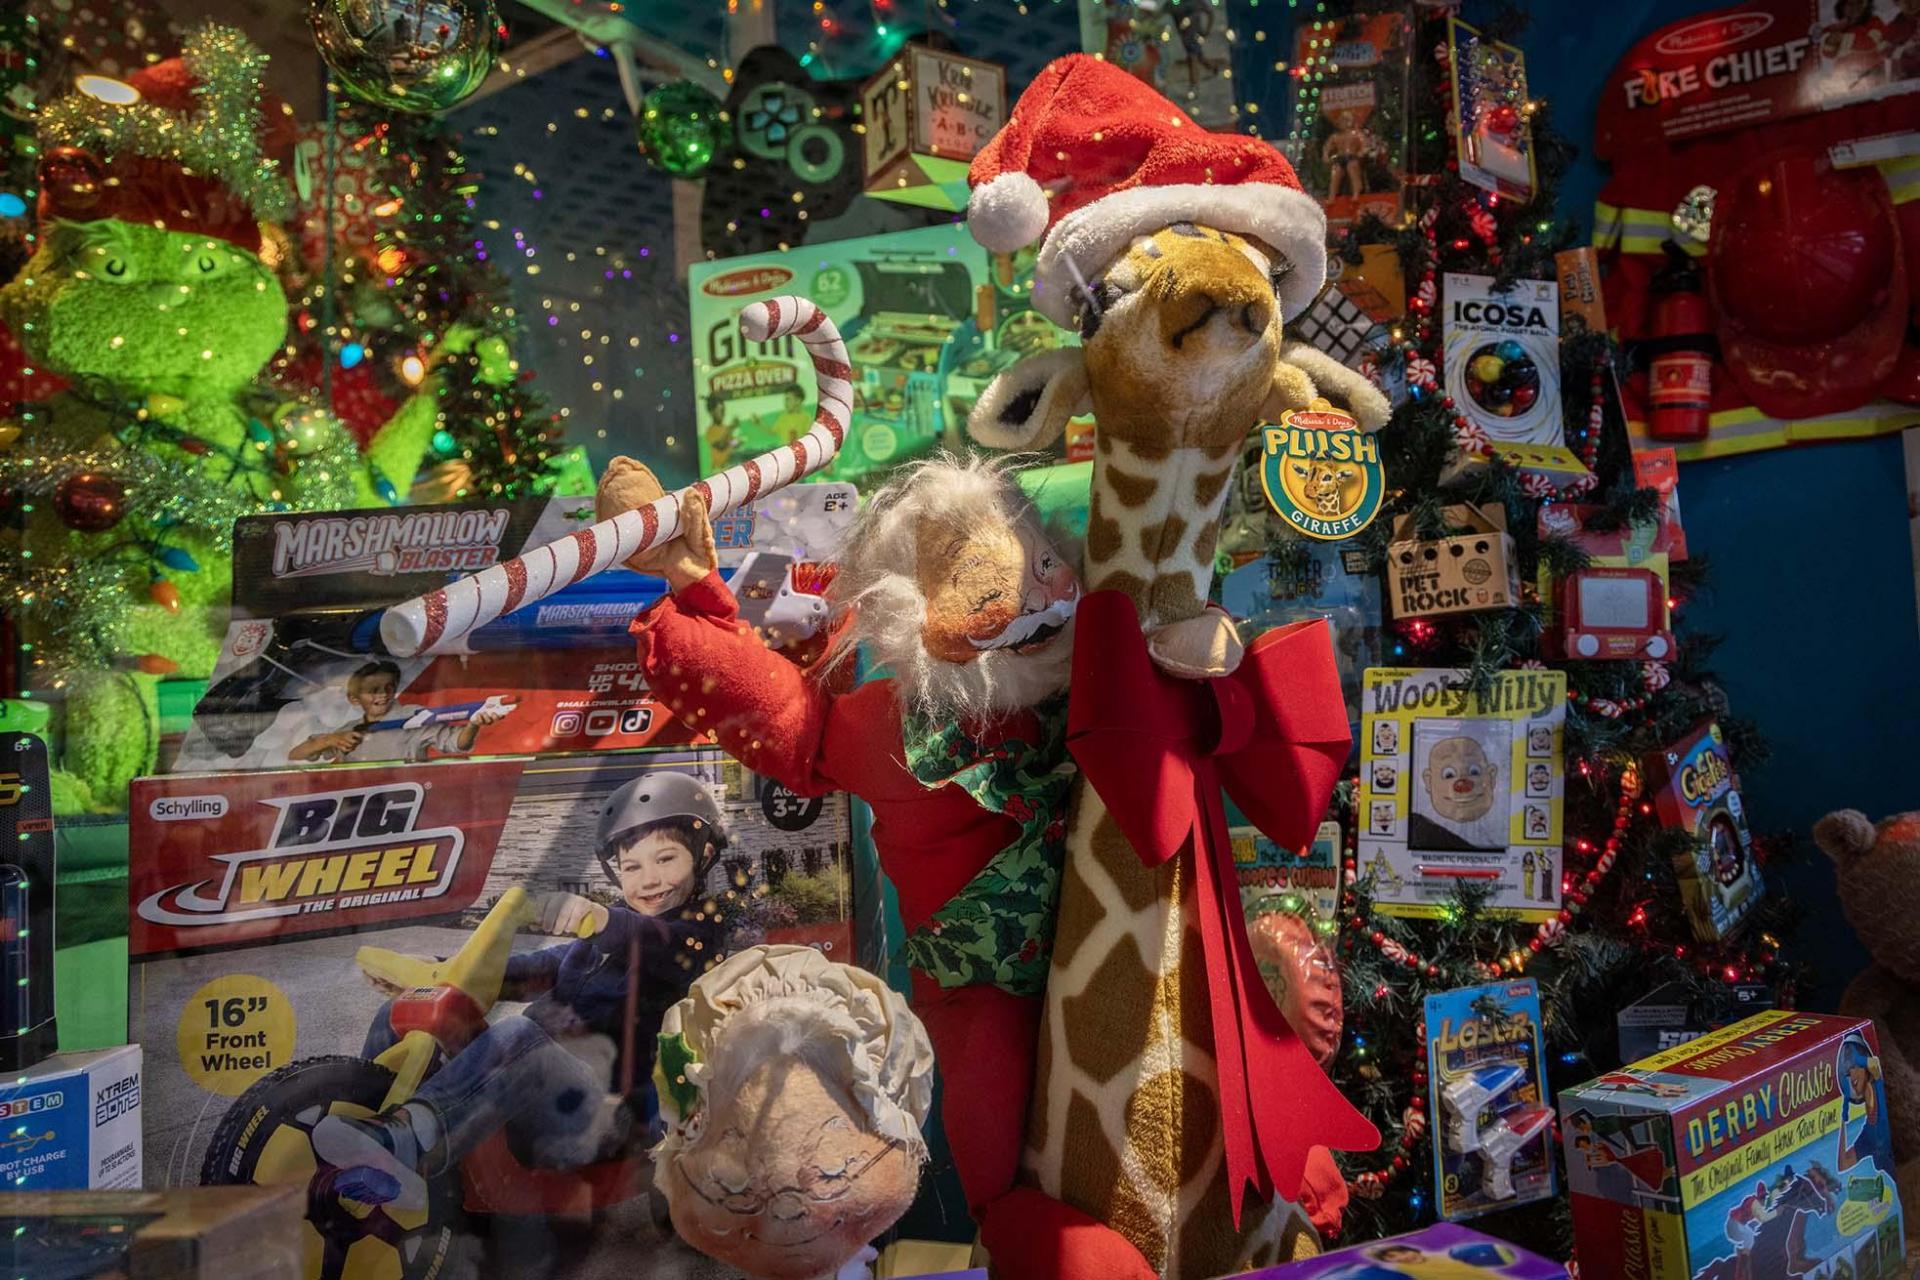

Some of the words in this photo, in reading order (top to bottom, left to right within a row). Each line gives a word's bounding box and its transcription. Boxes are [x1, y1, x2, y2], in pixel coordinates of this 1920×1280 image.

[1623, 65, 1700, 109] FIRE
[1704, 37, 1810, 89] CHIEF
[927, 86, 993, 119] KRIGLE
[1453, 301, 1549, 329] ICOSA
[712, 369, 752, 394] PIZZA
[1264, 429, 1378, 463] PLUSH
[825, 492, 849, 500] AGE
[1291, 510, 1363, 535] GIRAFFE
[272, 508, 511, 577] MARSHMALLOW
[398, 546, 499, 571] BLASTER
[1400, 572, 1441, 595] PET
[1402, 587, 1470, 613] ROCK
[537, 601, 644, 625] MARSHMALLOW
[588, 674, 615, 684] UP
[594, 662, 643, 673] SHOO
[589, 683, 613, 693] TO
[1475, 674, 1557, 719] Willy
[14, 742, 32, 752] 6+
[772, 786, 800, 797] AG
[156, 799, 222, 820] Schylling
[275, 789, 417, 848] BIG
[772, 797, 812, 818] 3-7
[239, 843, 438, 905] WHEEL
[303, 899, 335, 915] THE
[339, 889, 421, 909] ORIGINAL
[1738, 989, 1758, 1001] 5+
[206, 1031, 267, 1050] Front
[1742, 1017, 1824, 1049] DERBY
[201, 1051, 271, 1072] Wheel
[1683, 1044, 1757, 1071] Classic
[96, 1072, 140, 1105] XTREM
[0, 1092, 61, 1118] STEM
[95, 1087, 140, 1128] BOTS
[1688, 1083, 1772, 1157] DERBY
[1778, 1060, 1834, 1118] Classic
[228, 1145, 245, 1177] BIG
[237, 1104, 271, 1150] WHEEL
[22, 1149, 67, 1168] CHARGE
[1690, 1174, 1705, 1200] The
[1708, 1153, 1743, 1189] Original
[1745, 1141, 1773, 1165] Family
[1773, 1129, 1795, 1155] Horse
[1795, 1116, 1816, 1143] Race
[1817, 1107, 1838, 1135] Game
[6, 1169, 21, 1181] BY
[23, 1164, 46, 1177] USB
